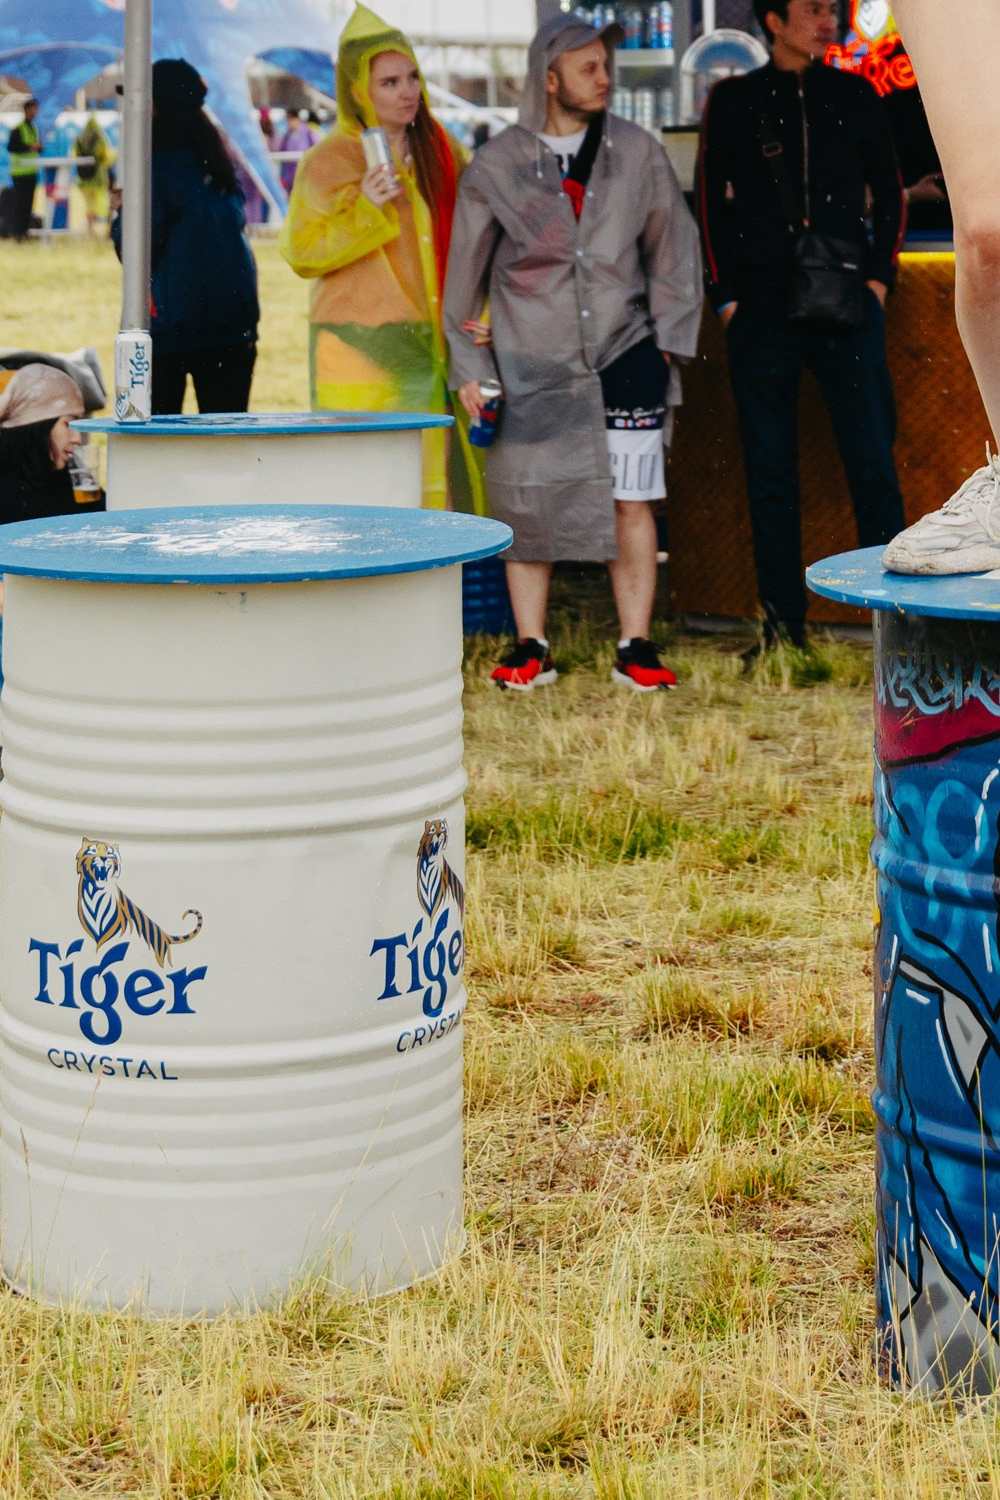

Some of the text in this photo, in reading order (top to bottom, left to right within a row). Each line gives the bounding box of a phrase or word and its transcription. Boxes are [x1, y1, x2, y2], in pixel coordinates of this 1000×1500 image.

[129, 341, 150, 389] Tiger
[369, 907, 464, 1018] Tige
[28, 937, 208, 1046] Tiger
[396, 1008, 463, 1053] CRYSTA
[47, 1047, 179, 1080] CRYSTAL
